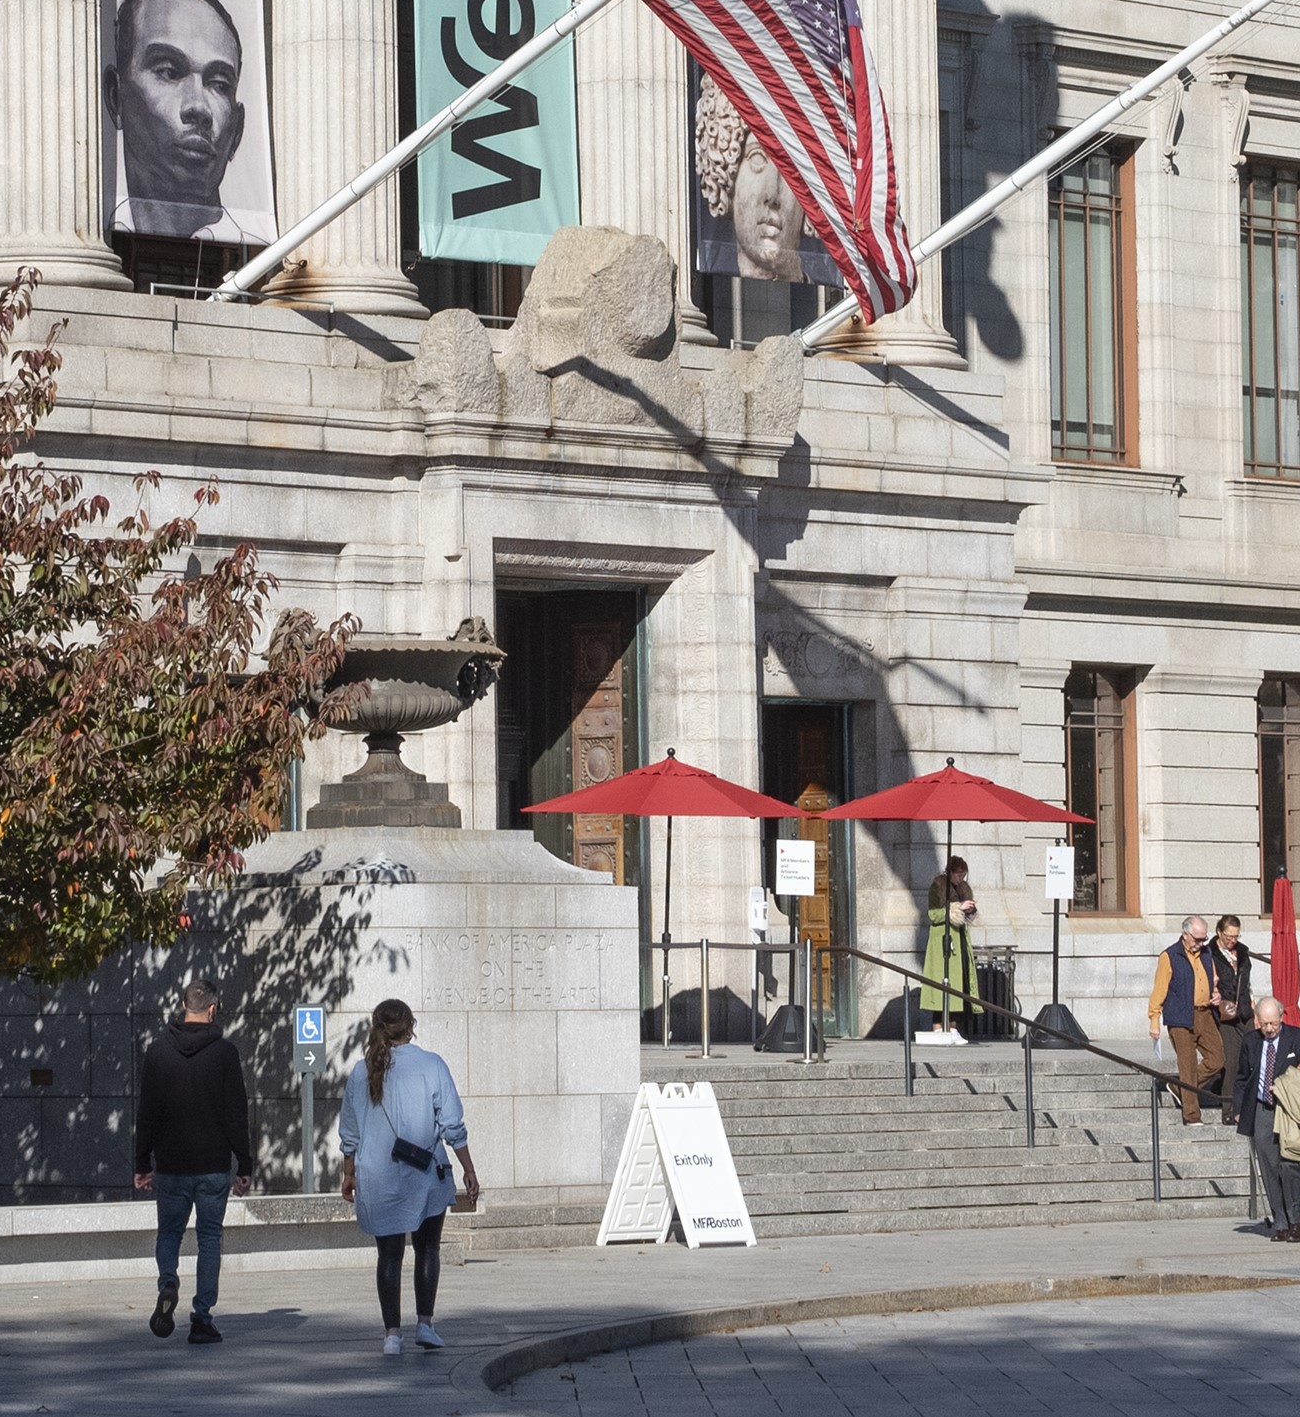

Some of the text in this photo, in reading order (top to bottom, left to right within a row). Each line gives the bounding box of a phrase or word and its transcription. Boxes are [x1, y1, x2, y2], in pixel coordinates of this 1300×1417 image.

[406, 934, 615, 952] BANK OF AMERICA PLAZA
[481, 961, 545, 977] ON THE
[424, 988, 598, 1004] AVENUE OF THE ARTS
[674, 1154, 713, 1167] Exit Only
